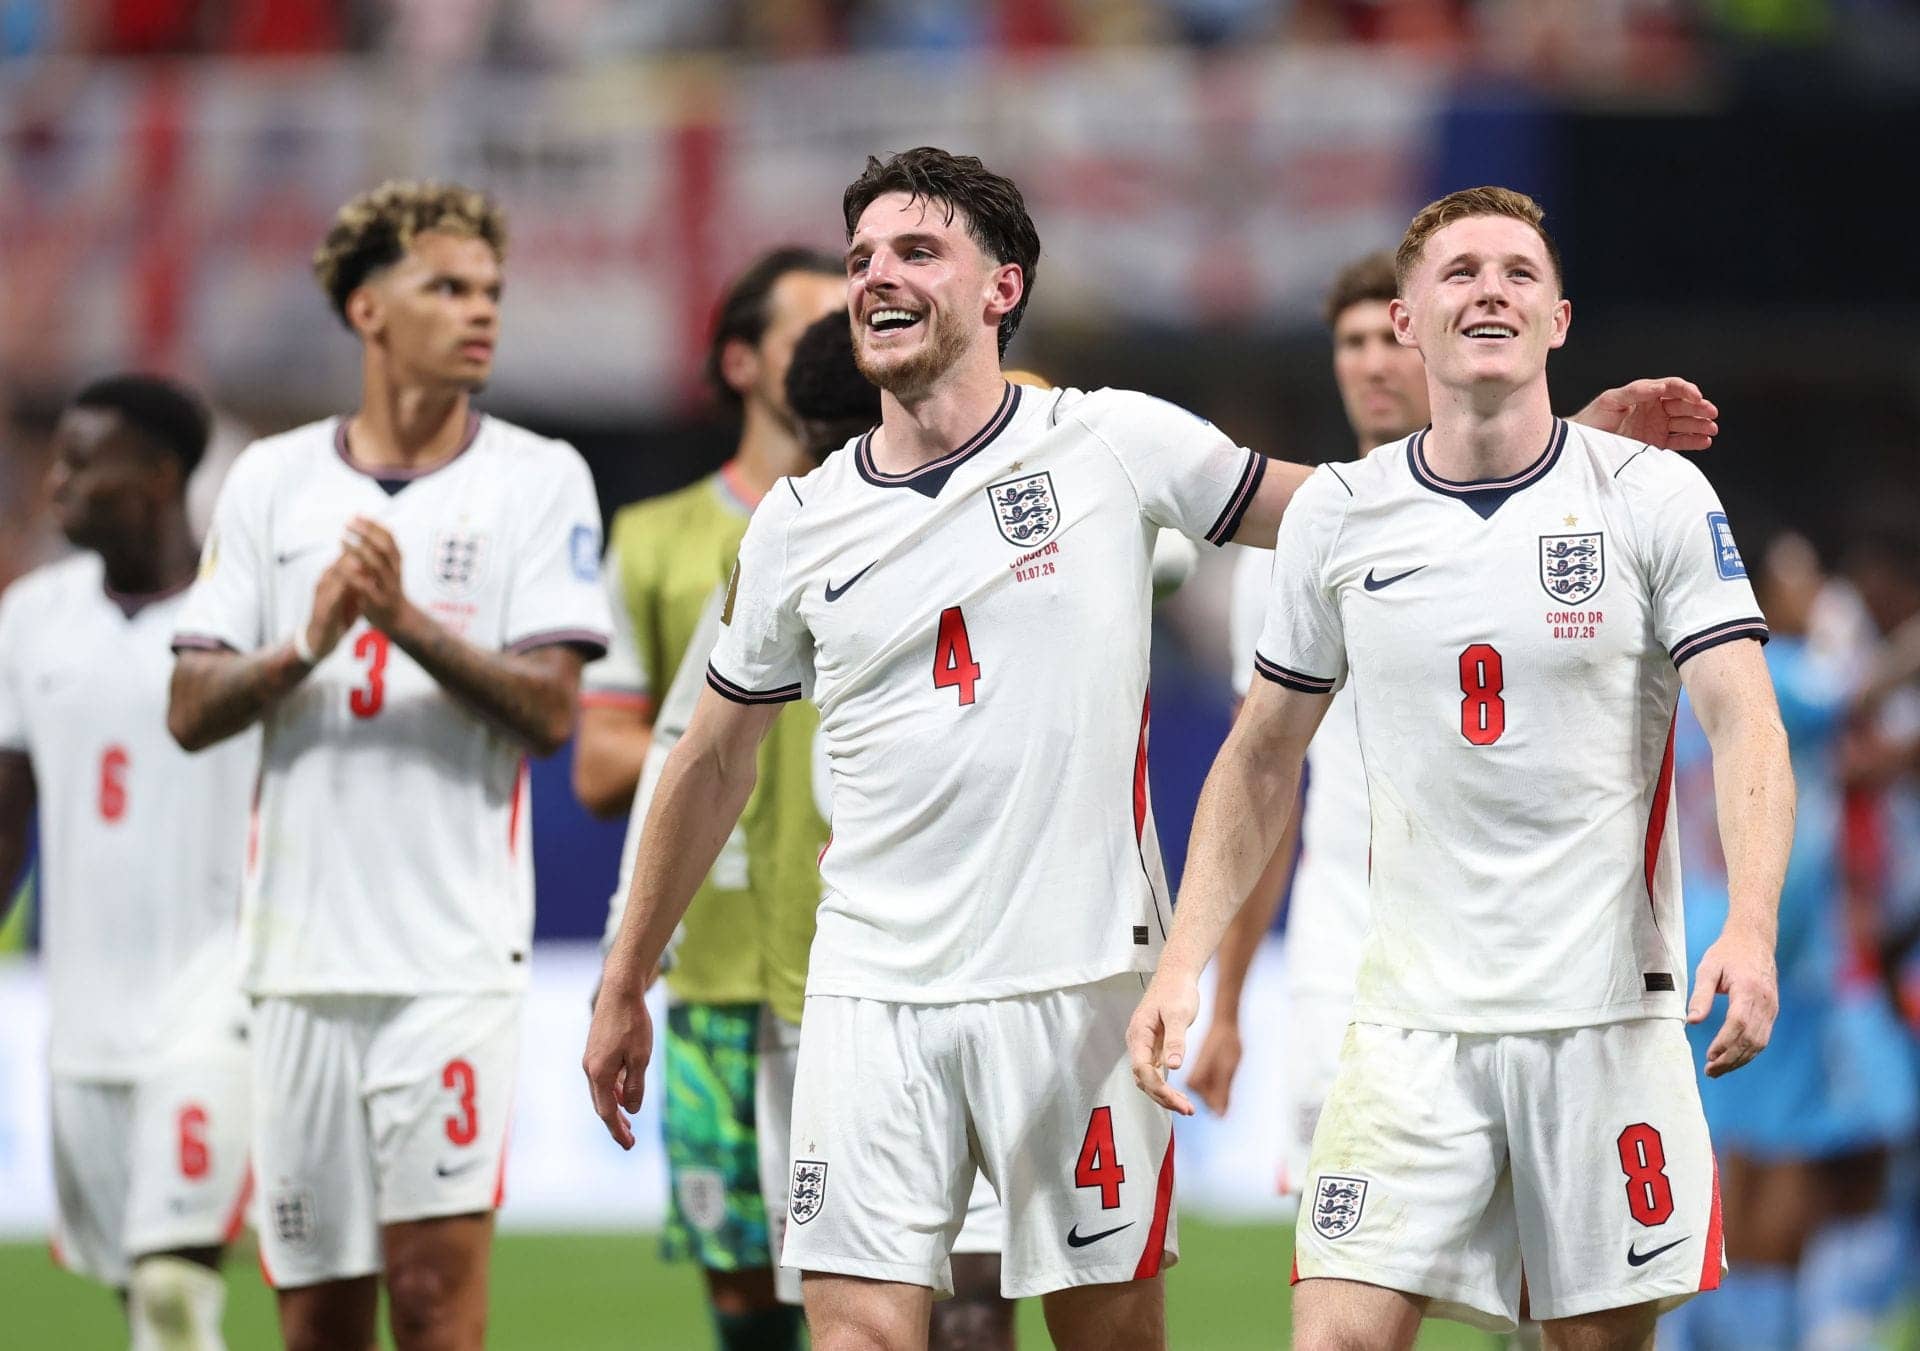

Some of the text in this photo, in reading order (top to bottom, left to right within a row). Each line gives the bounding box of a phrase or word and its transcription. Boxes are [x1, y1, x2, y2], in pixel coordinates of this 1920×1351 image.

[1016, 562, 1056, 582] 01.07.26
[1044, 541, 1059, 555] DR
[932, 606, 982, 706] 4
[1546, 611, 1604, 624] CONGO DR
[1553, 626, 1596, 639] 01.07.26
[350, 627, 391, 718] 3
[1459, 643, 1505, 746] 8
[98, 746, 129, 824] 6
[177, 1103, 211, 1180] 6
[441, 1058, 480, 1147] 3
[1075, 1106, 1125, 1210] 4
[1616, 1122, 1675, 1227] 8
